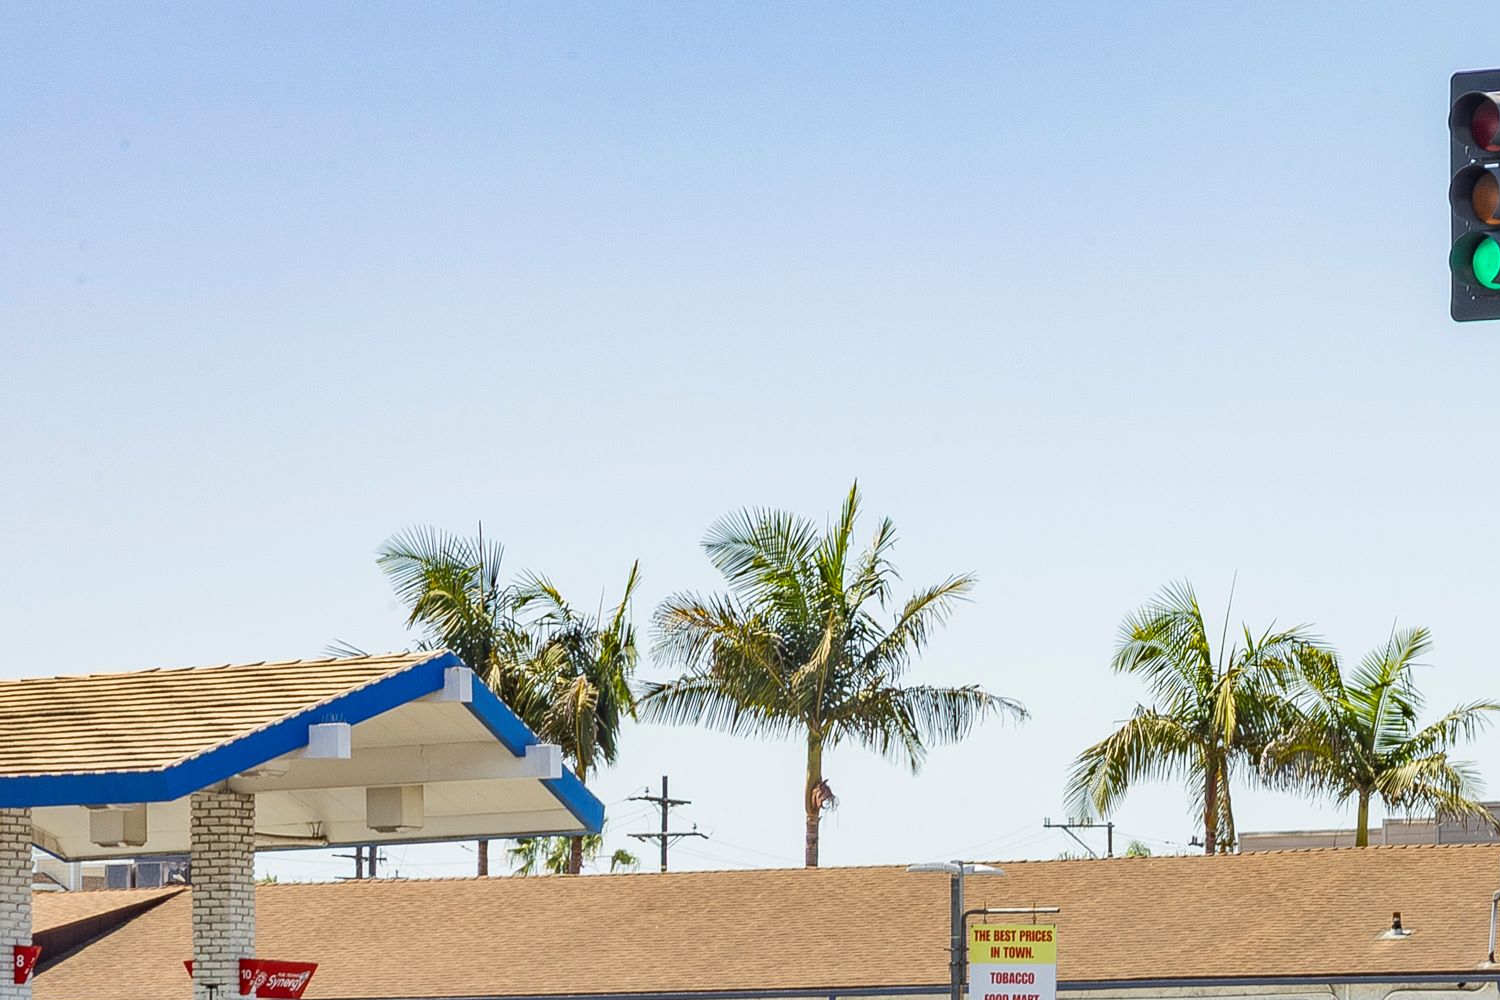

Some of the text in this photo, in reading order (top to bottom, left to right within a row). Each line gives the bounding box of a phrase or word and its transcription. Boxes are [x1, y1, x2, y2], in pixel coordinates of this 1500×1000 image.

[974, 930, 1053, 942] THE BEST PRICES
[990, 946, 1034, 959] IN TOWN.
[16, 954, 25, 968] 8
[241, 968, 252, 980] 10
[990, 972, 1035, 985] TOBACCO
[266, 974, 305, 992] Synergy
